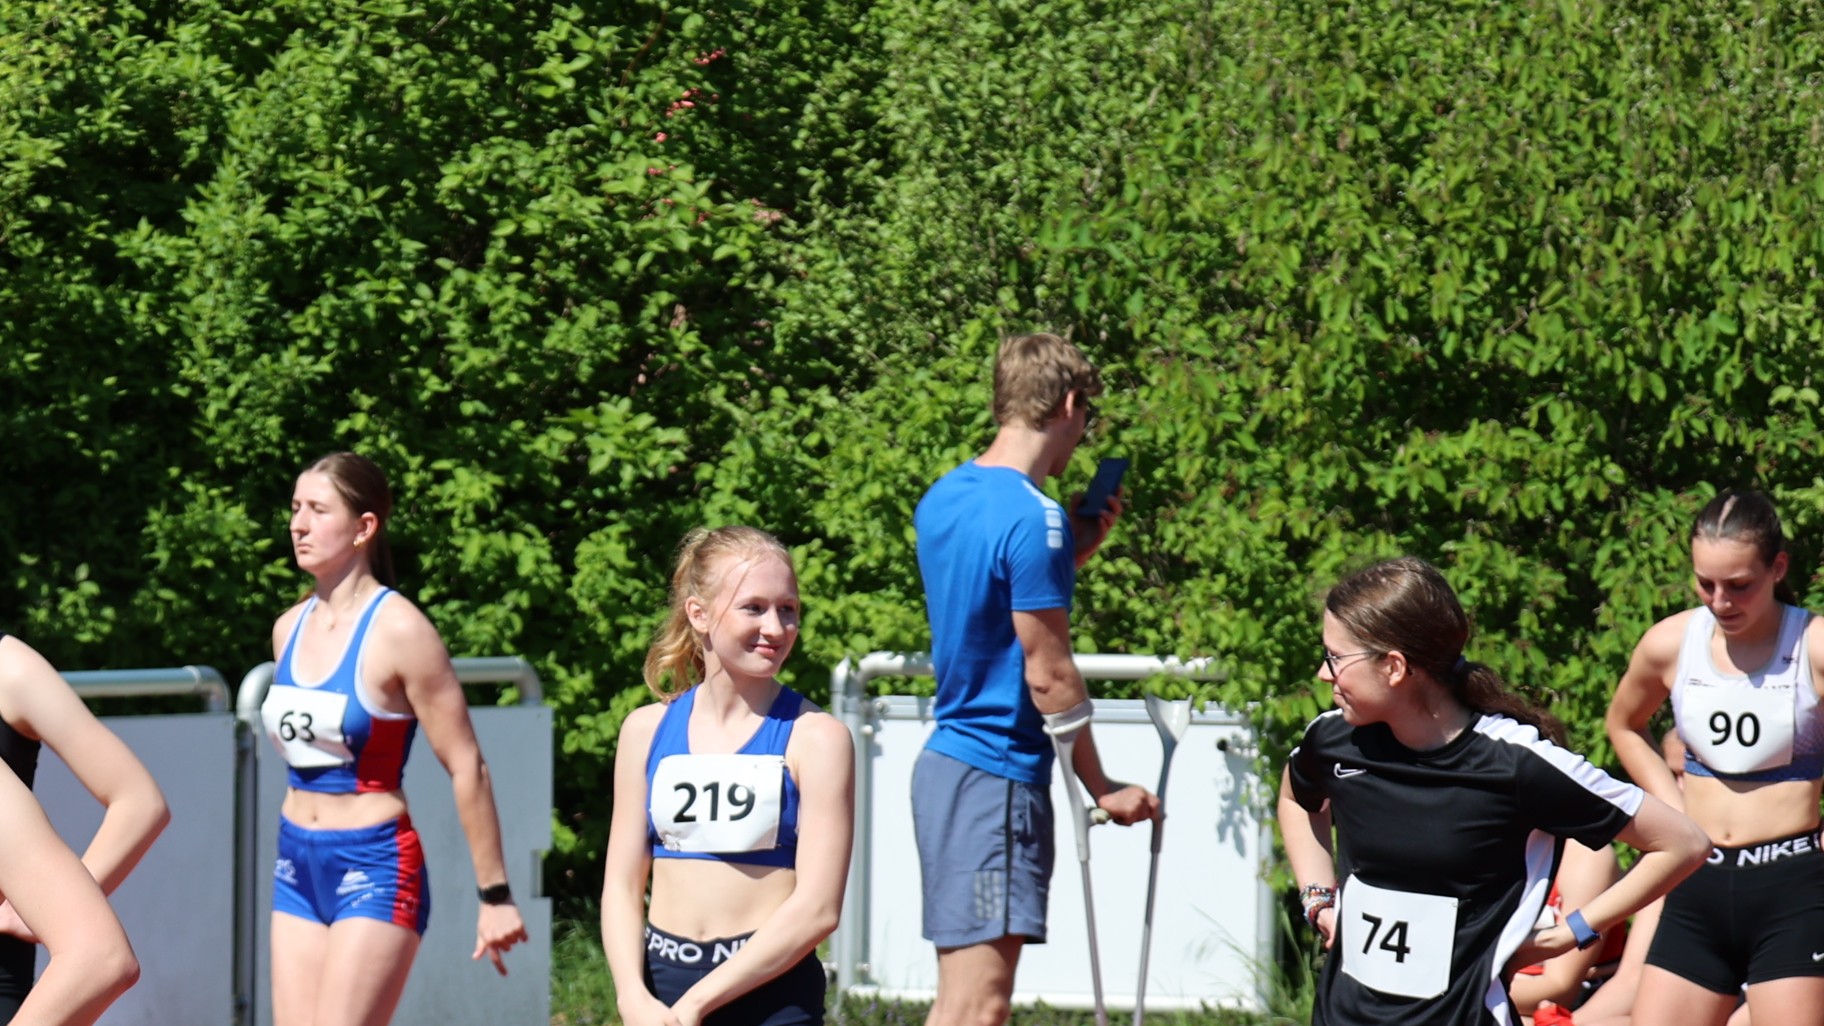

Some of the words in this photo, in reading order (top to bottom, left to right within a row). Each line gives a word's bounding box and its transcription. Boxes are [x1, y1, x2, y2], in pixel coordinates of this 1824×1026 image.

[279, 711, 315, 743] 63
[1708, 711, 1760, 747] 90
[672, 781, 756, 823] 219
[1737, 836, 1812, 867] NIKE
[648, 932, 703, 963] PRO
[1361, 911, 1411, 964] 74
